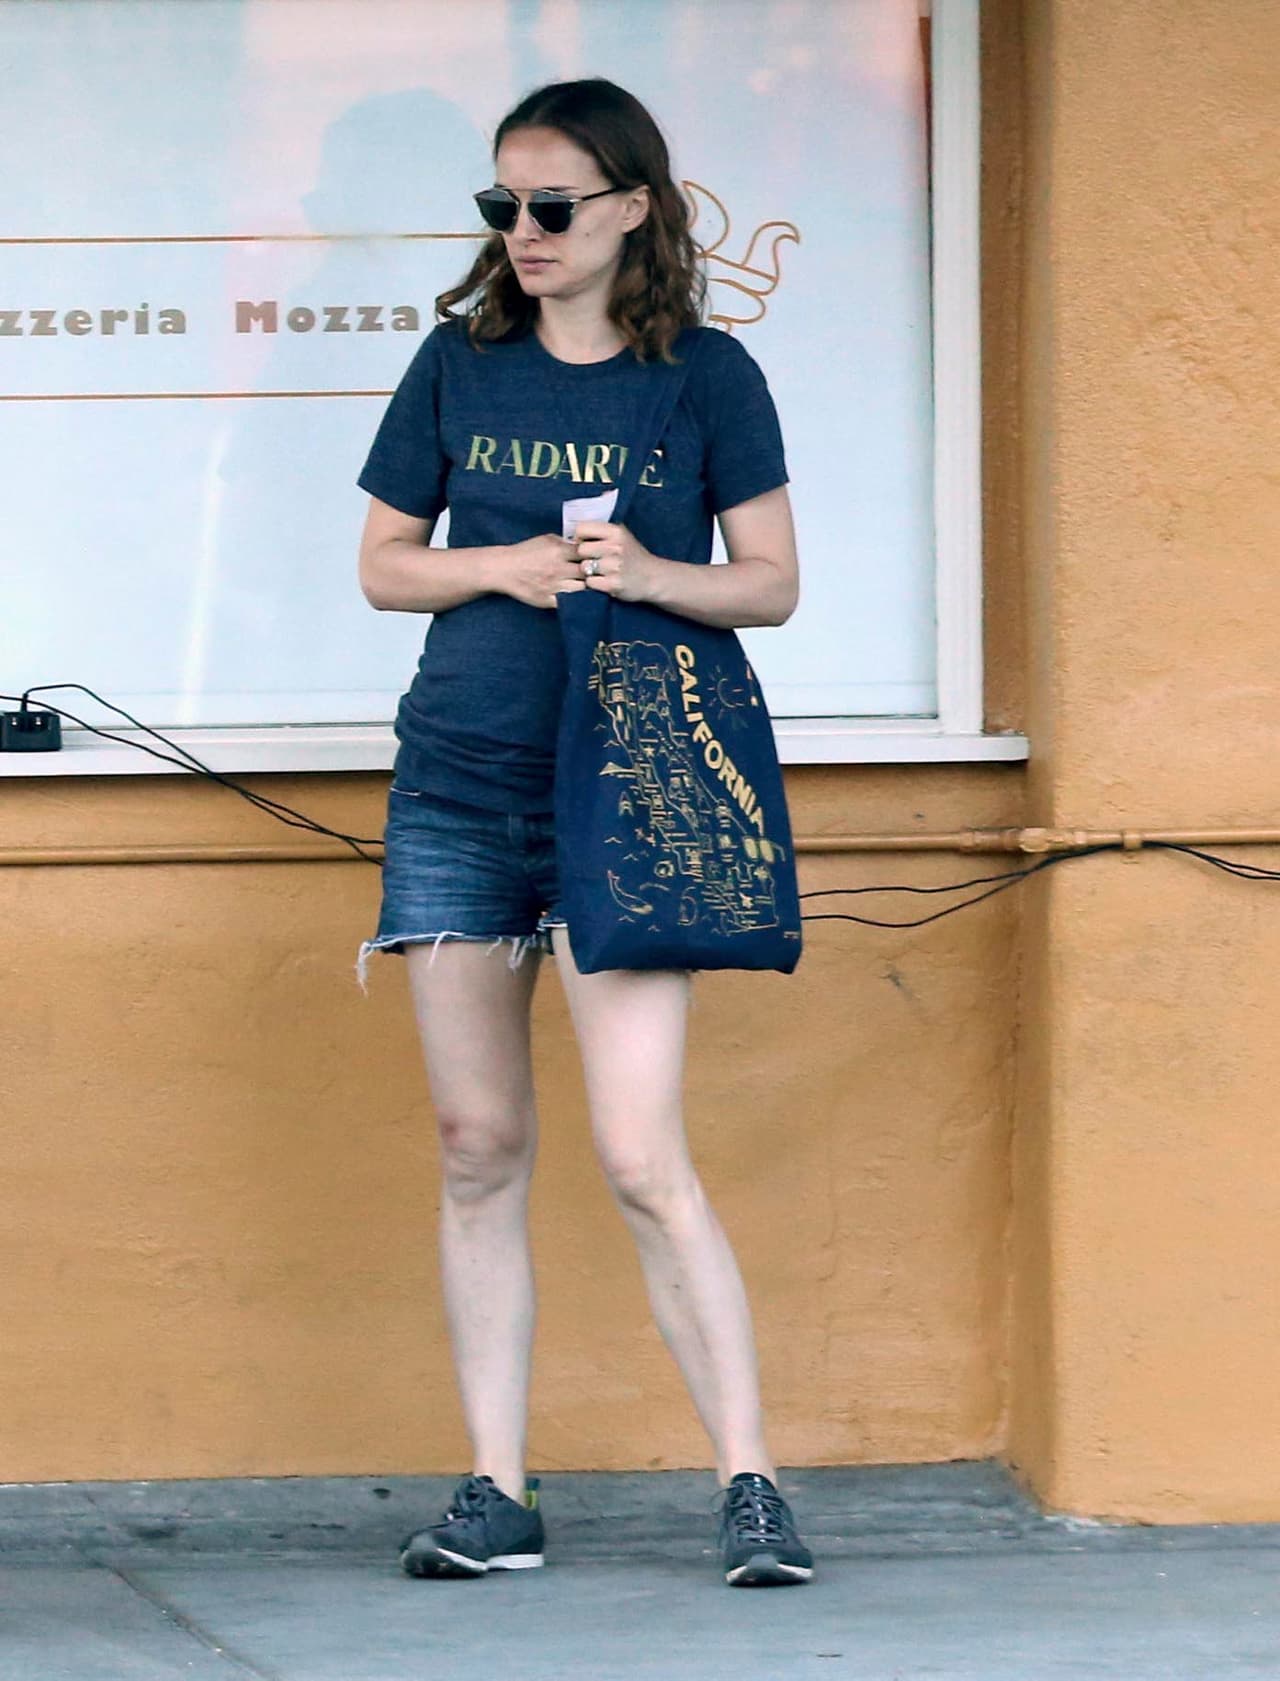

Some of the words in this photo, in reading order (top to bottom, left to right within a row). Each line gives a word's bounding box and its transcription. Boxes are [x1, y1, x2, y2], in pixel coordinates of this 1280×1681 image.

[0, 302, 187, 335] zzeria
[235, 301, 419, 332] Mozza
[674, 643, 766, 834] CALIFORNIA
